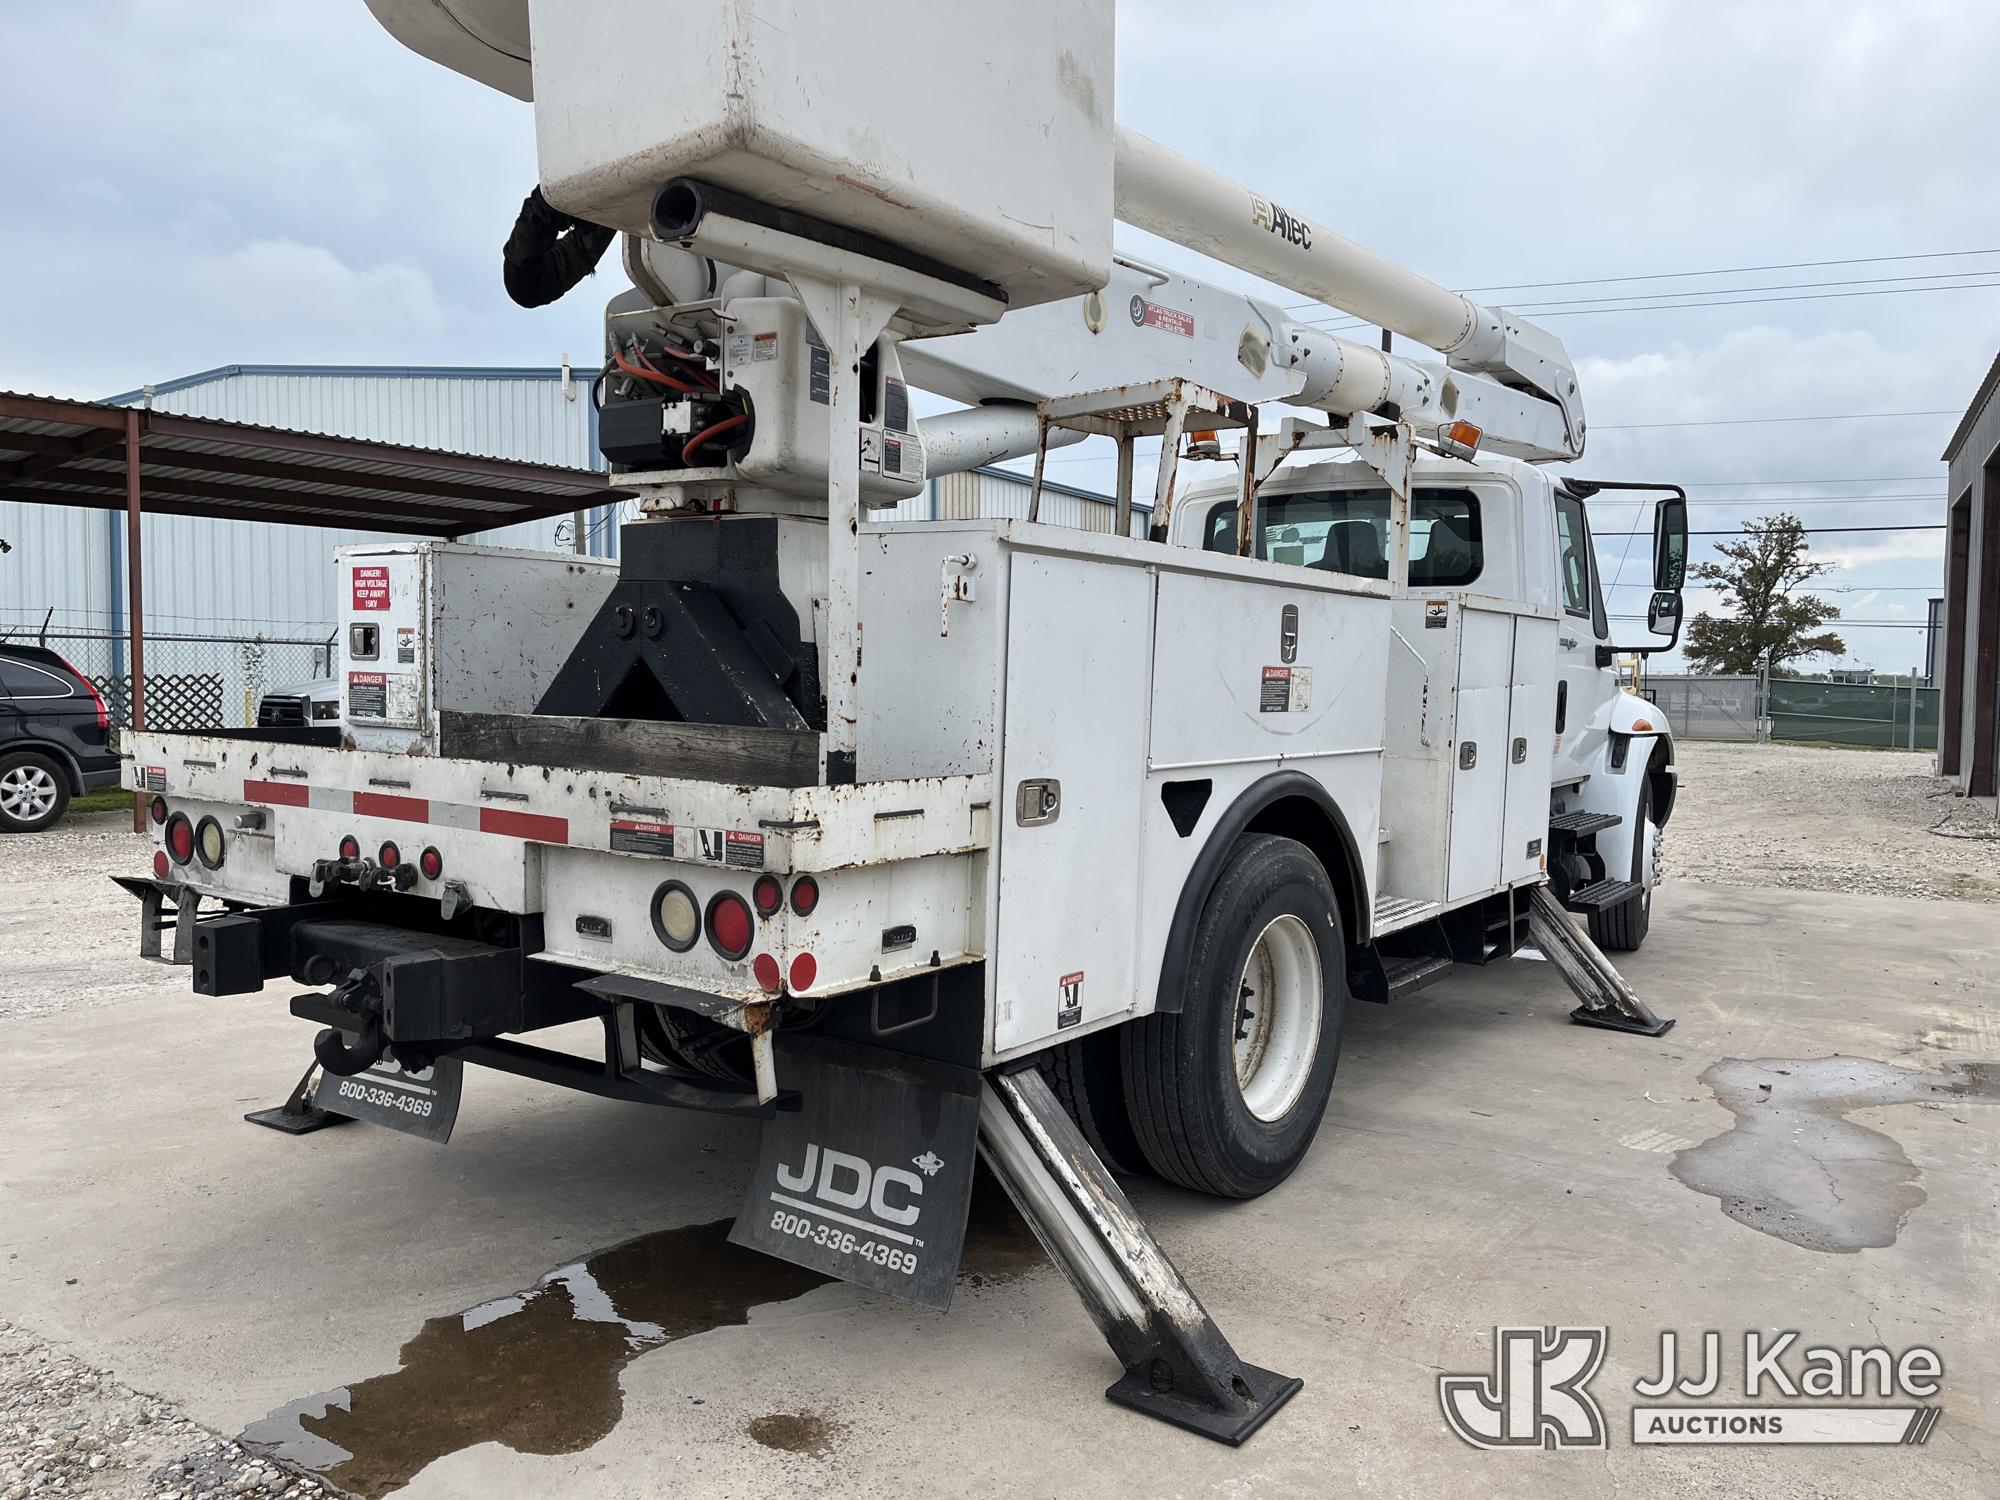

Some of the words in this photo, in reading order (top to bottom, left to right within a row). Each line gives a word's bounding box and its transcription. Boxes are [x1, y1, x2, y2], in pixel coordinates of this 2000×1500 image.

[1269, 201, 1311, 250] Altec
[1148, 305, 1163, 315] ATLAS
[1163, 309, 1178, 319] TRUCK
[1178, 314, 1192, 324] SALES
[360, 569, 381, 578] DANGER!
[354, 579, 366, 588] HIGH
[367, 579, 388, 588] VOLTAGE
[356, 589, 369, 598] KEEP
[365, 599, 378, 608] 15KV
[1270, 669, 1288, 678] DANGER
[359, 674, 383, 684] DANGER
[639, 824, 661, 833] DANGER
[738, 833, 762, 842] DANGER
[338, 1080, 433, 1117] 800-336-4369
[776, 1142, 924, 1227] JDC
[769, 1210, 918, 1275] 800-336-4369
[914, 1238, 925, 1248] TM
